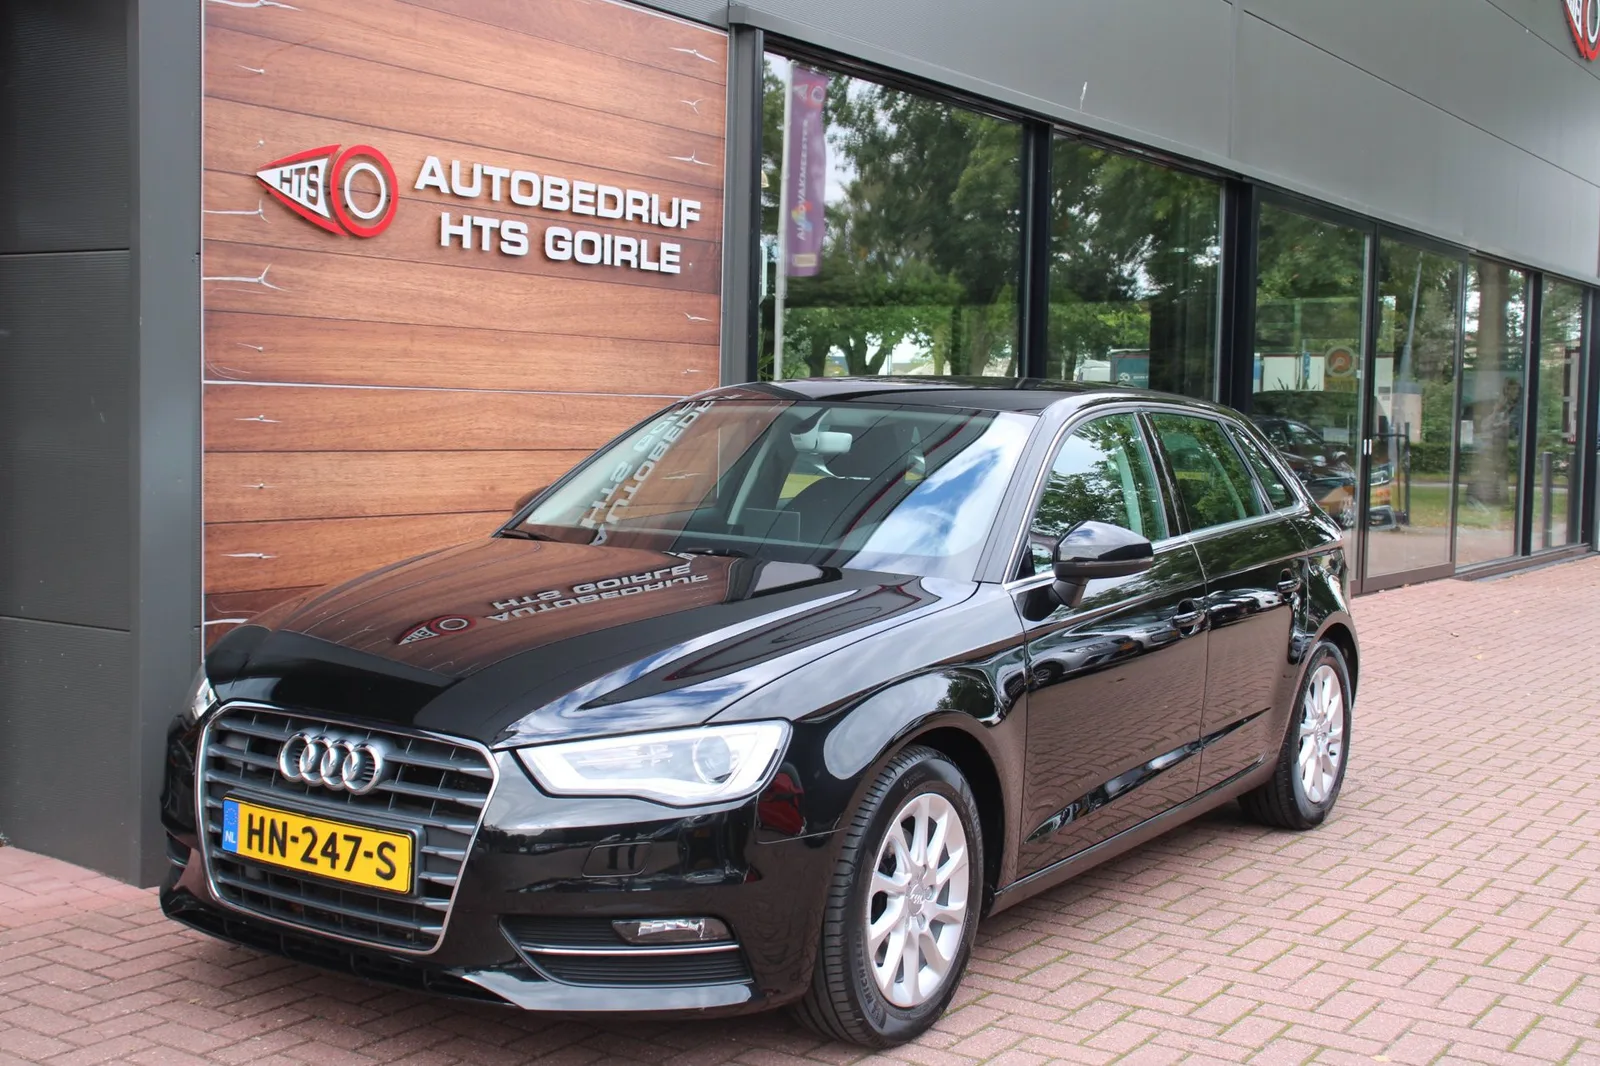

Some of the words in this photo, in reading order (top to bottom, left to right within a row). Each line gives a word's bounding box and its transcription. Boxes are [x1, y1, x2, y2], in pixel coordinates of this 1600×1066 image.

[280, 165, 319, 206] HTS
[414, 155, 702, 229] AUTOBEDRIJF
[441, 212, 529, 256] HTS
[544, 226, 682, 274] GOIRLE
[224, 830, 237, 844] NL
[247, 813, 397, 881] HN-247-S
